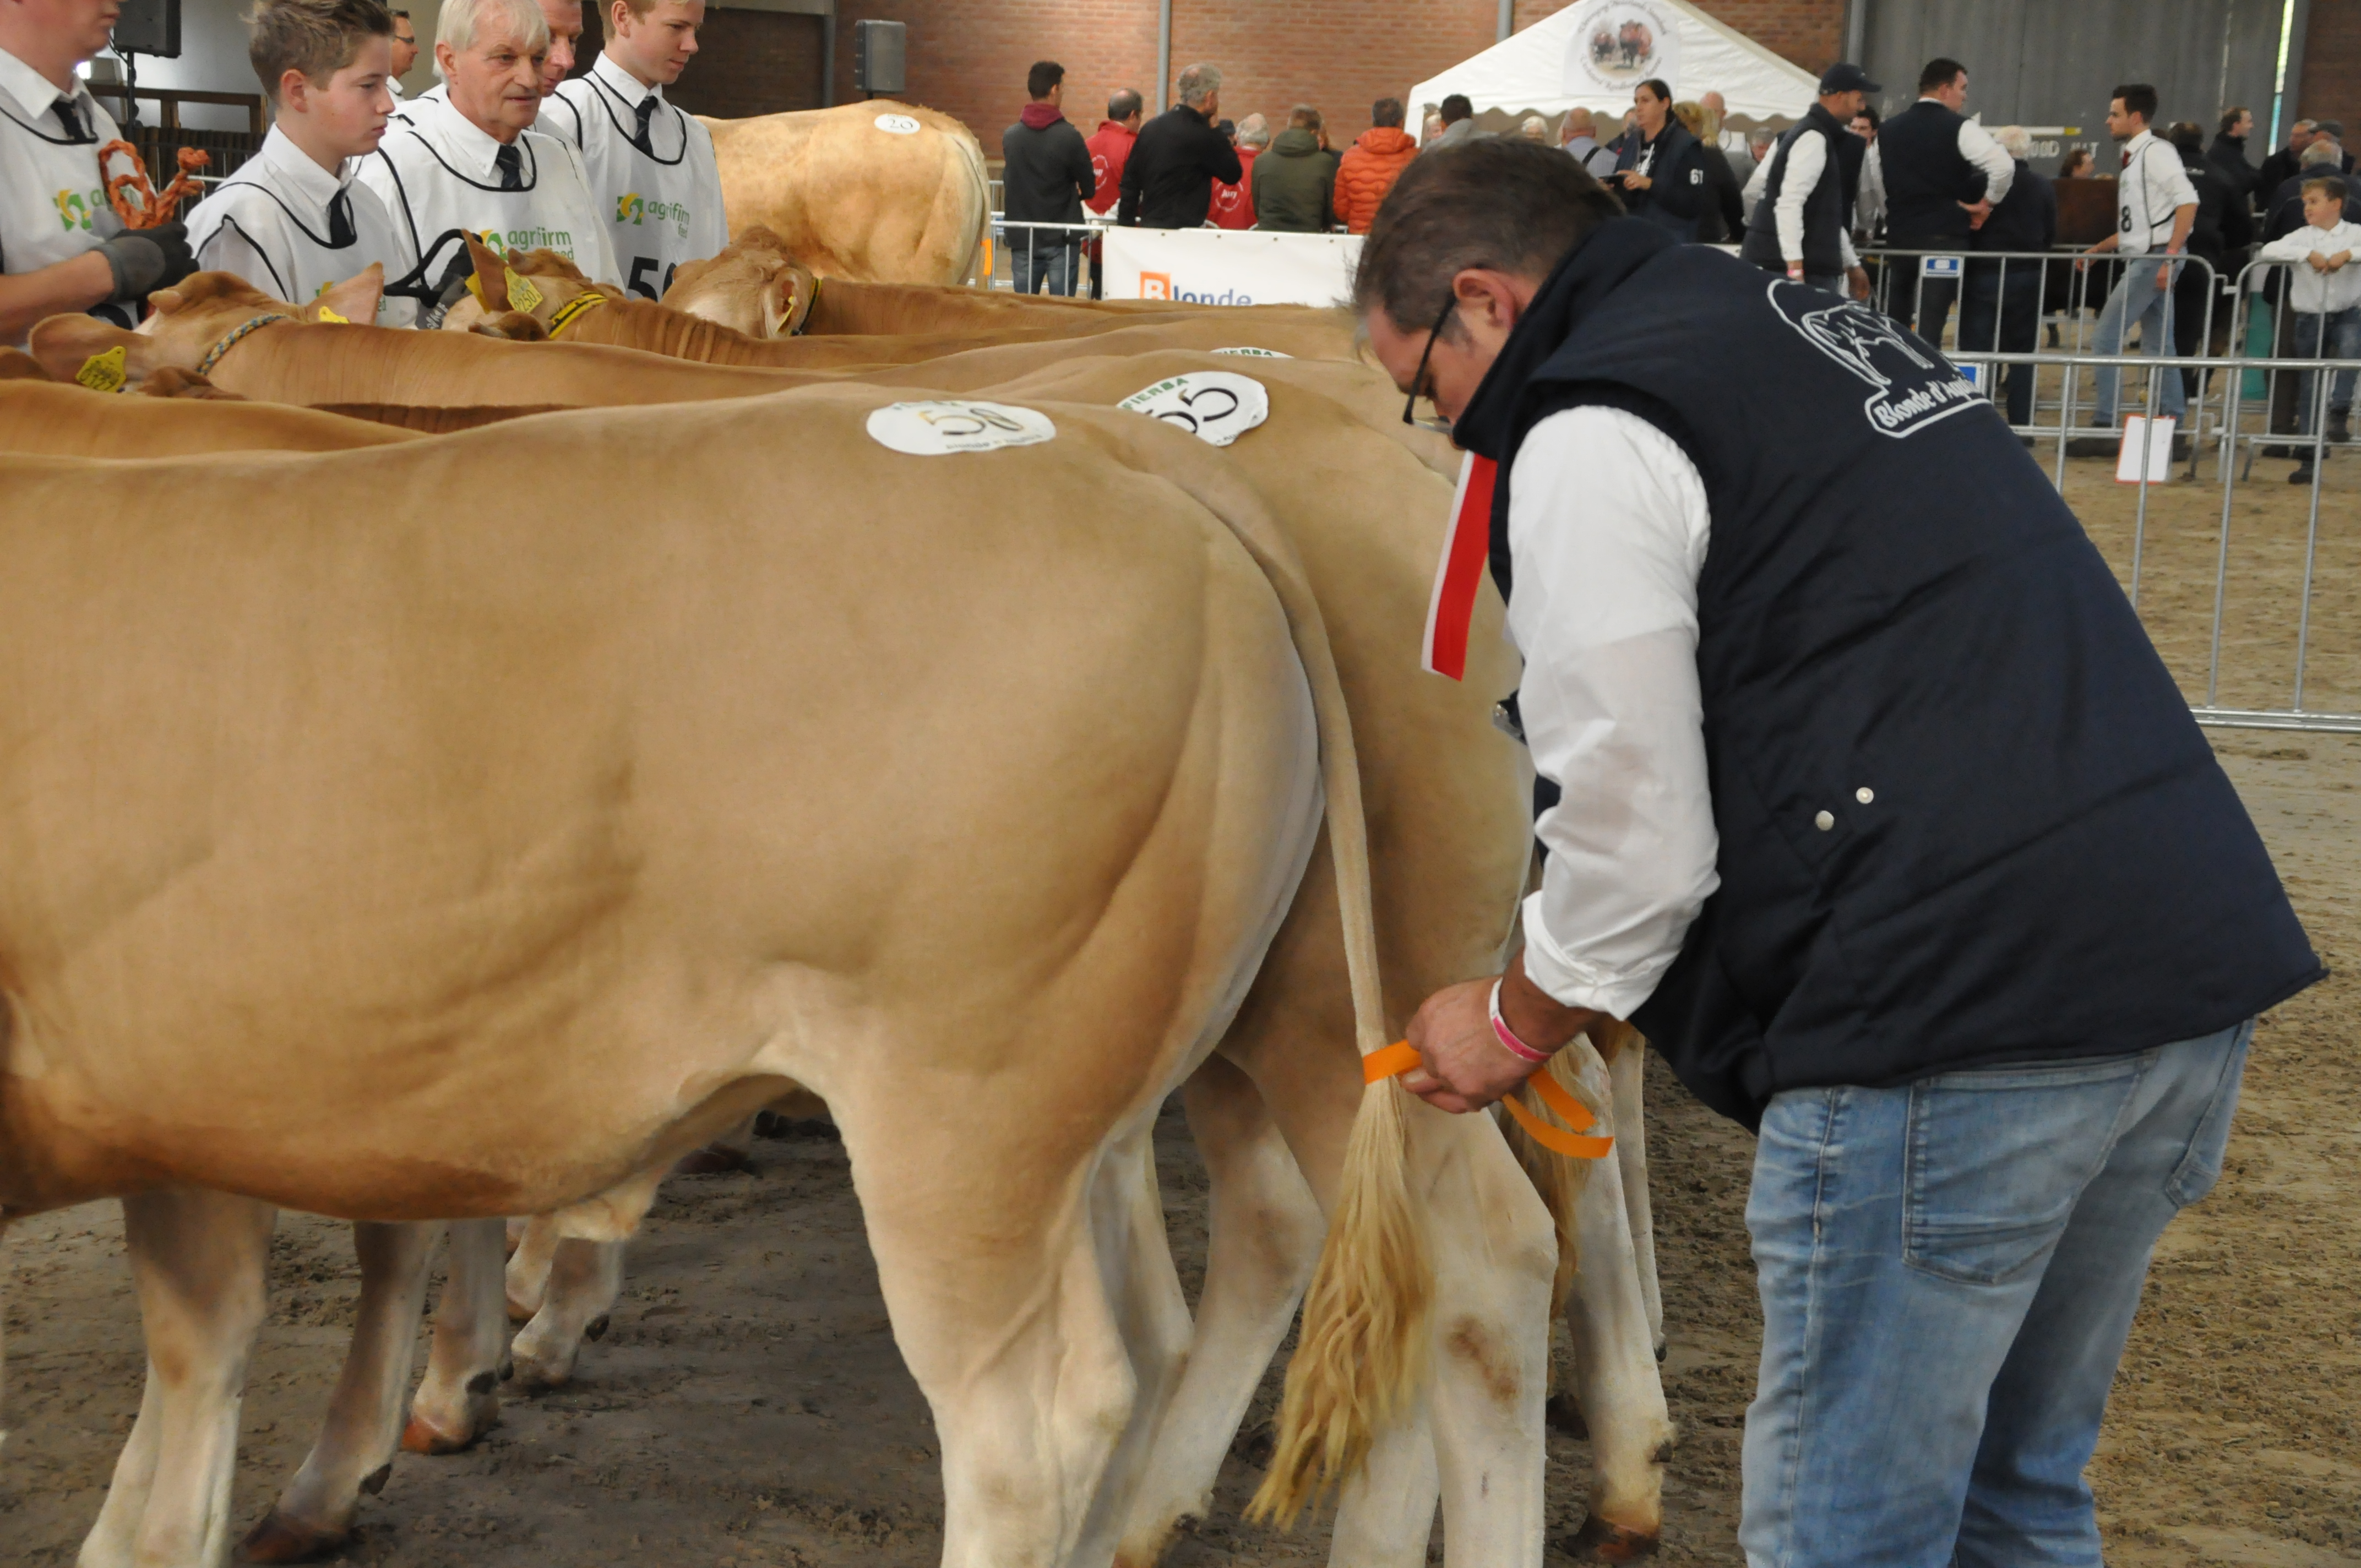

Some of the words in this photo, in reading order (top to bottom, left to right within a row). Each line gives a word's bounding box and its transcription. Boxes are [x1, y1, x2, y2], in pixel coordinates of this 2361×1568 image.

[1144, 278, 1252, 306] Blonde
[1122, 377, 1189, 411] FIERBA
[1873, 388, 1937, 428] Blonde
